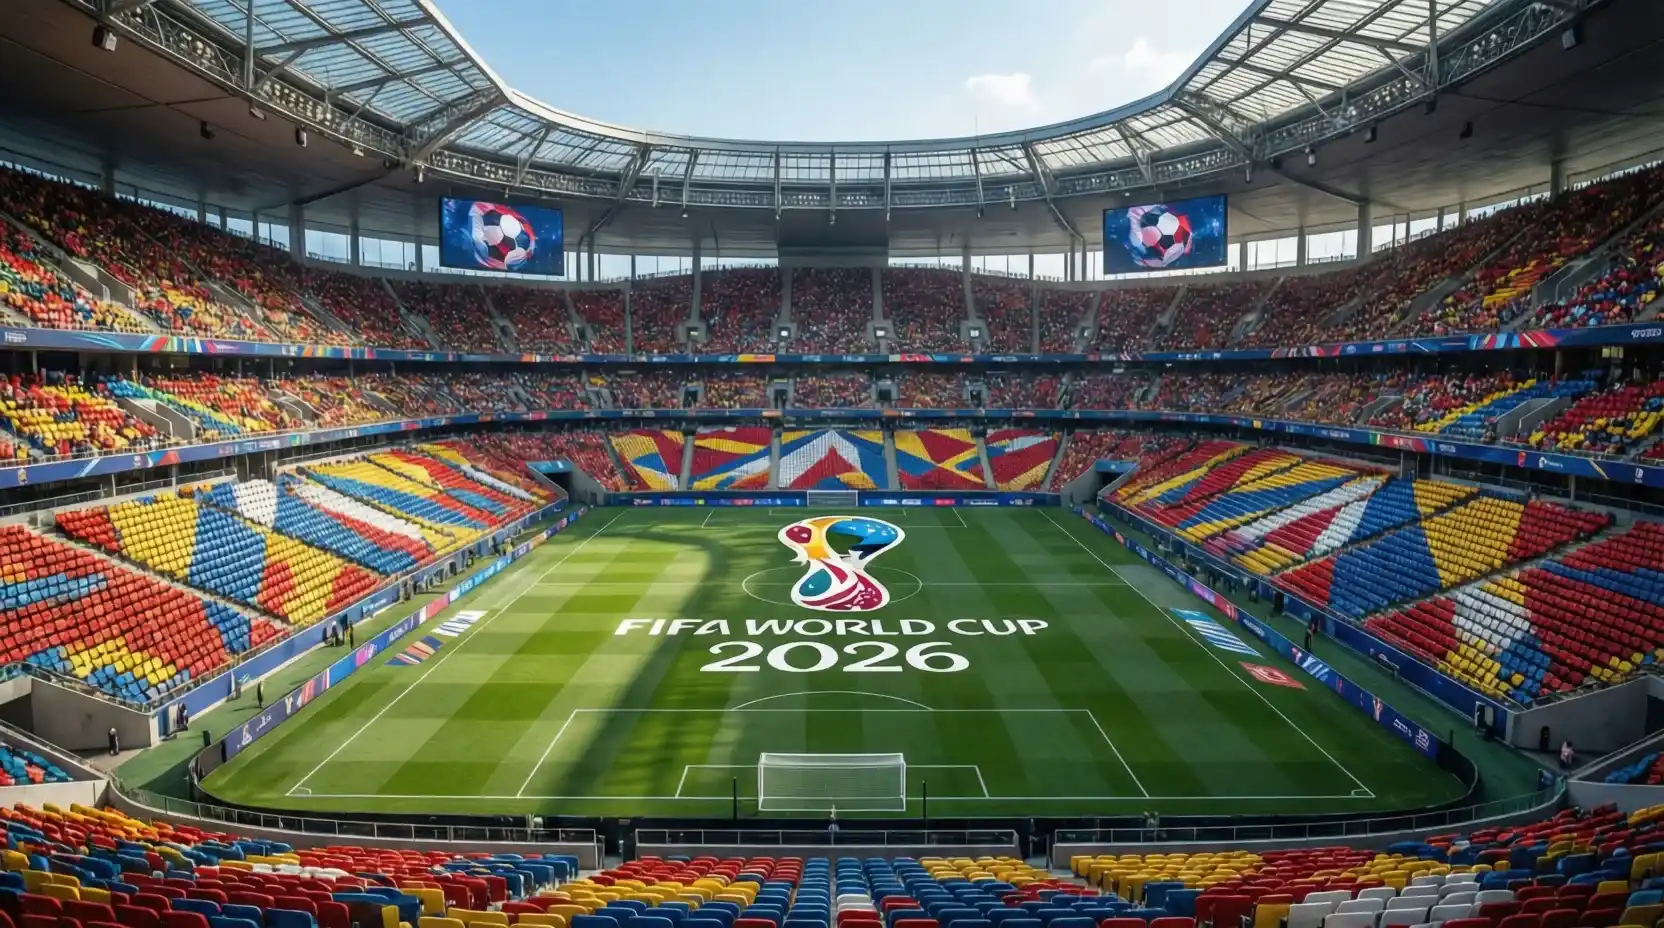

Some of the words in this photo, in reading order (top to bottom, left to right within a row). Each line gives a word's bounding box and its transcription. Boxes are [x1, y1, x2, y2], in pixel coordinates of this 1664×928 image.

[615, 619, 731, 636] FIFA
[746, 619, 936, 636] WORLD
[947, 619, 1049, 636] CUP
[700, 641, 970, 673] 2026
